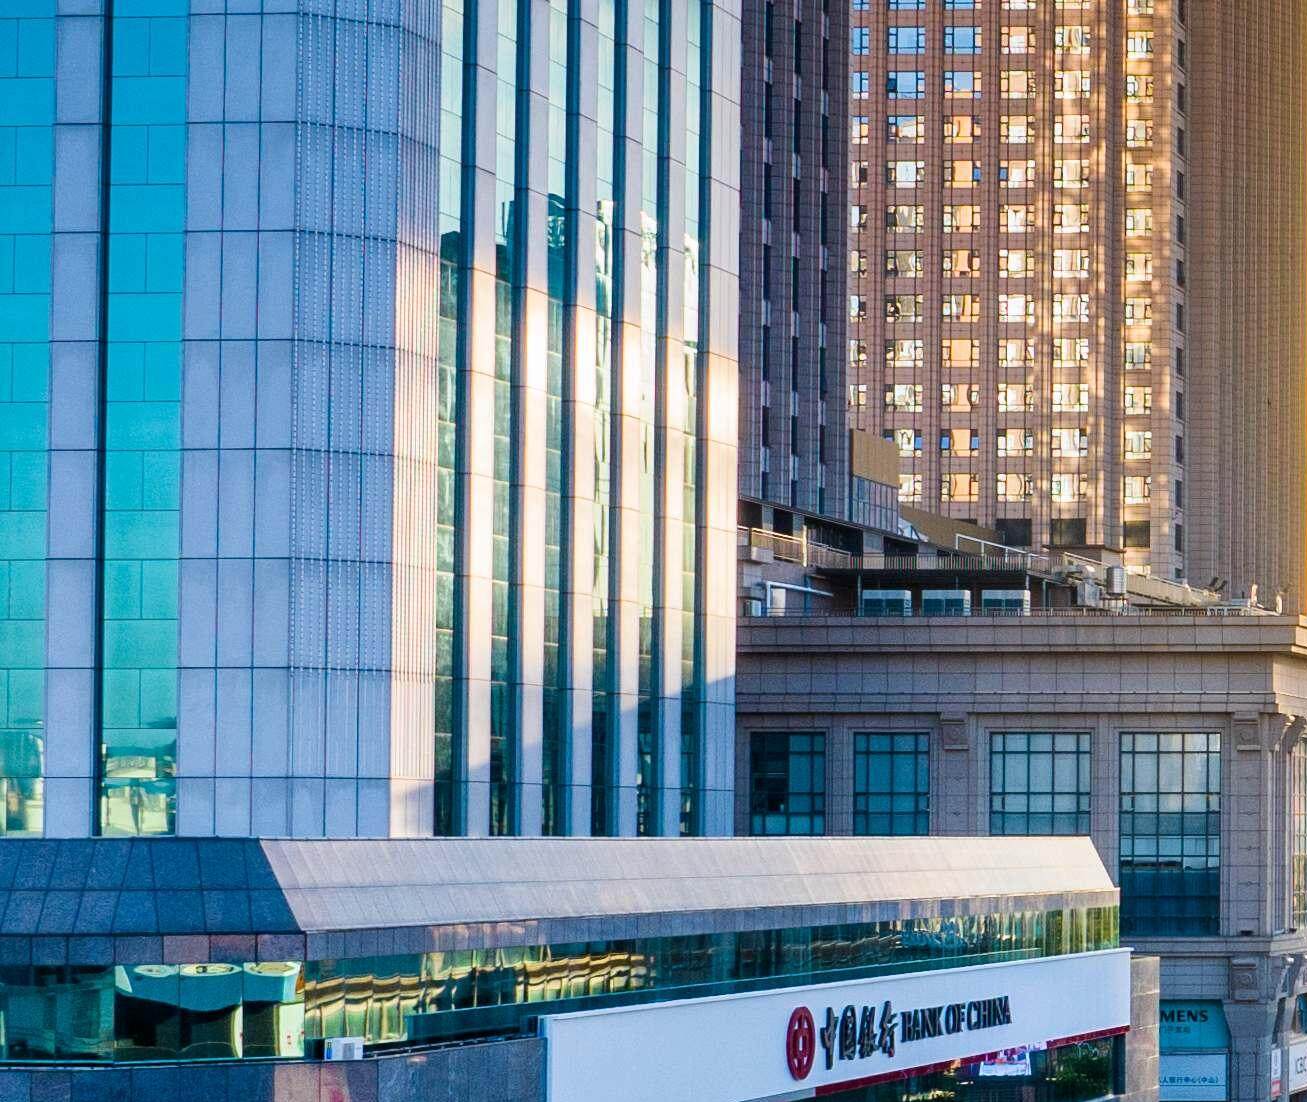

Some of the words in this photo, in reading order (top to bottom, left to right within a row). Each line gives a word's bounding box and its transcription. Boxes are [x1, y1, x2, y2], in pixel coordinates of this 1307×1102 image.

[820, 1000, 898, 1070] 中国银行
[901, 1005, 944, 1043] BANK
[945, 1002, 967, 1035] OF
[966, 995, 1013, 1031] CHINA
